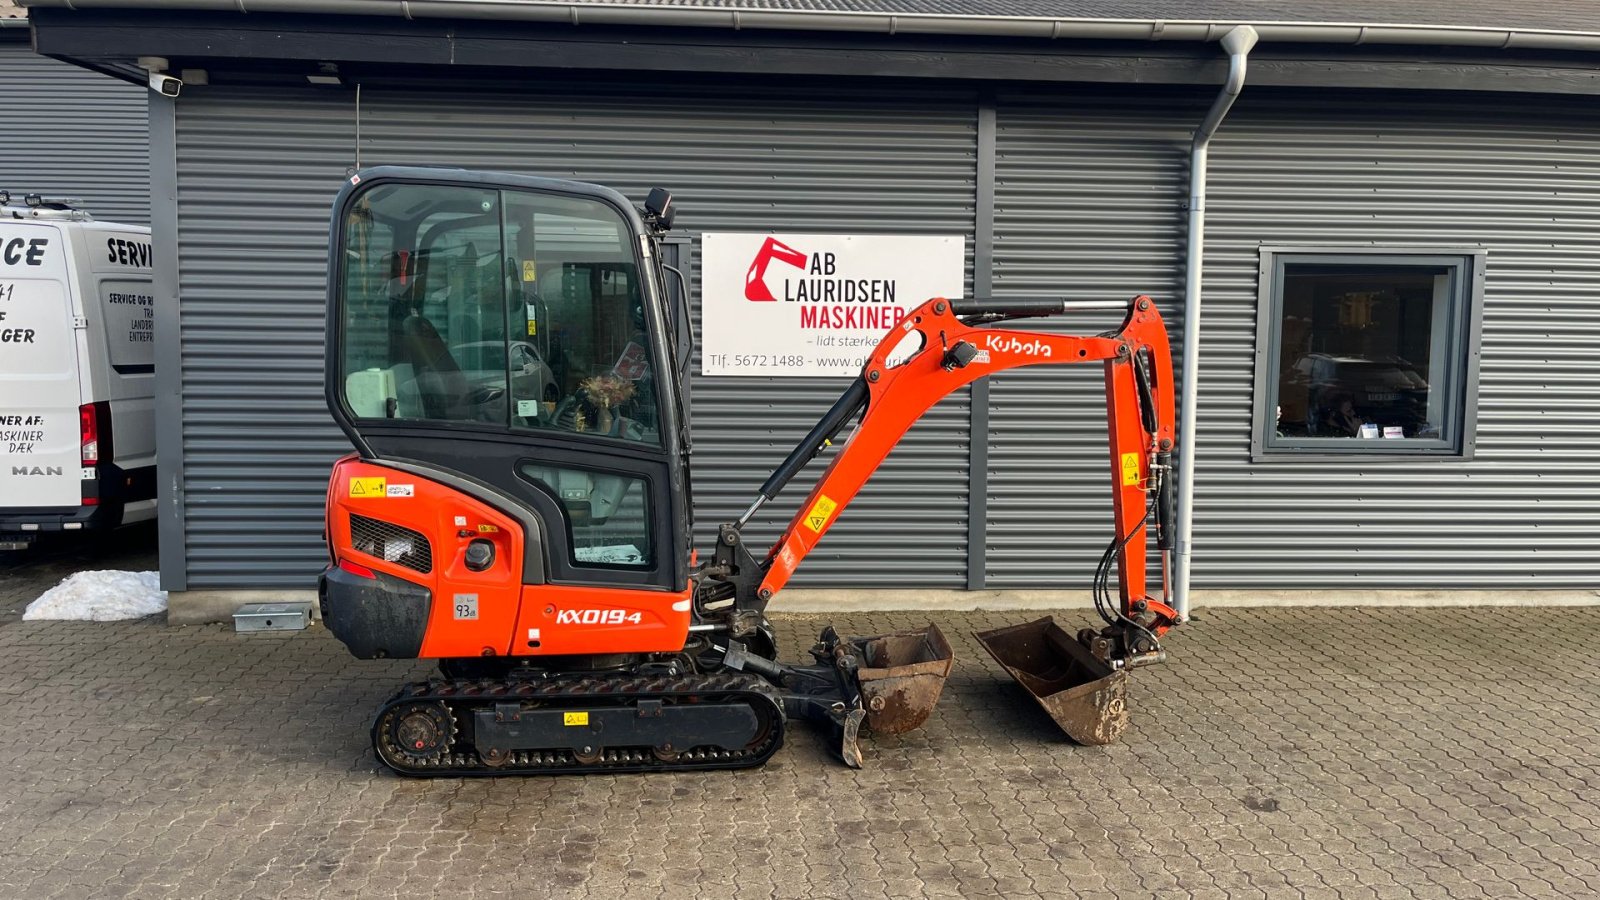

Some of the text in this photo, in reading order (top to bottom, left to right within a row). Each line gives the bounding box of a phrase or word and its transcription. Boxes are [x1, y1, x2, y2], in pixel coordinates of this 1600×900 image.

[0, 237, 48, 266] CE
[810, 252, 836, 276] AB
[785, 278, 896, 303] LAURIDSEN
[109, 293, 136, 305] SERVICE
[138, 296, 146, 306] OG
[800, 305, 905, 330] MASKINER
[816, 336, 835, 347] lidt
[986, 334, 1052, 357] Kubota
[709, 354, 730, 369] Tlf.
[735, 355, 767, 366] 5672
[771, 355, 804, 366] 1488
[25, 415, 44, 426] AF:
[8, 442, 35, 454] DÆK
[12, 466, 63, 476] MAN
[456, 604, 470, 617] 93
[556, 609, 642, 624] KX019-4
